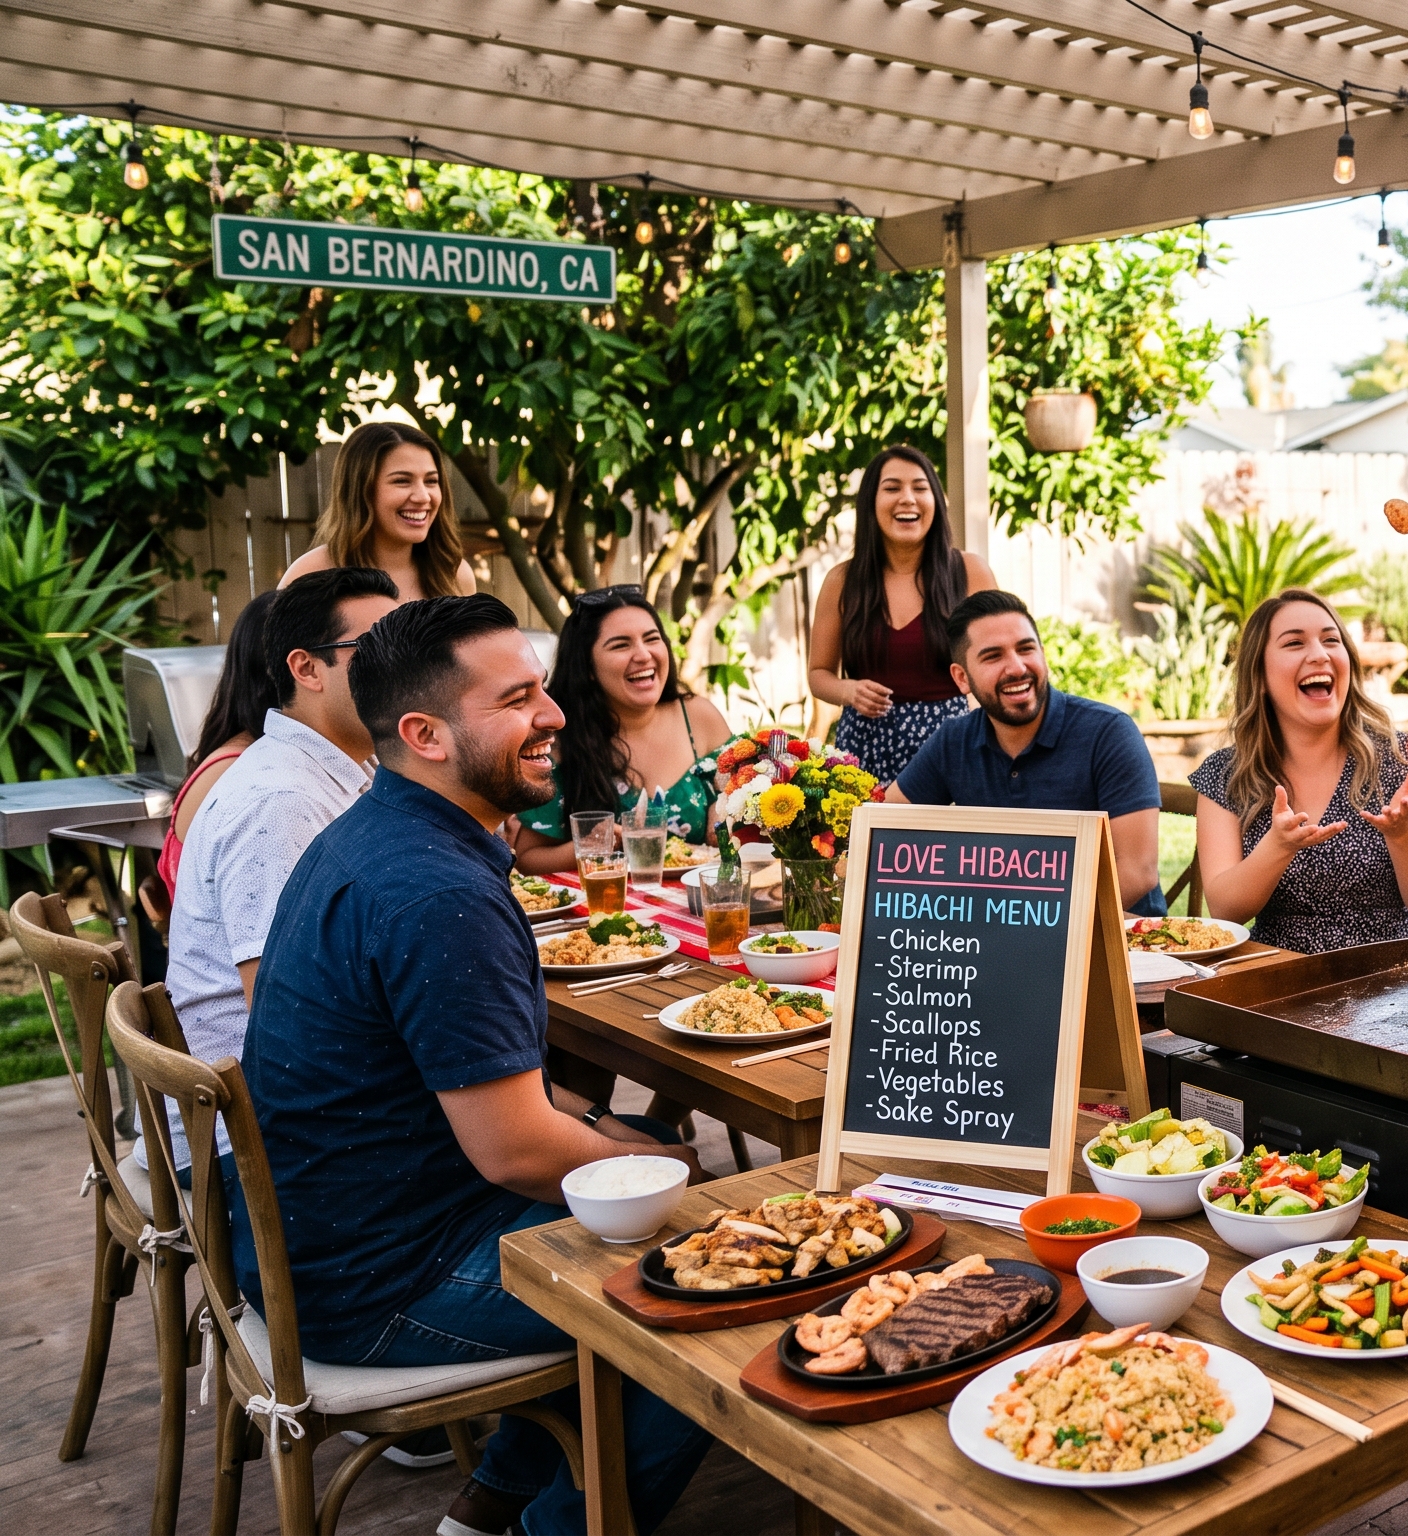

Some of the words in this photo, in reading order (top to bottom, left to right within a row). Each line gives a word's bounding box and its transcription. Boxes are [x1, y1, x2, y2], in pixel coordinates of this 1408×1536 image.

[237, 229, 310, 273] SAN
[328, 236, 548, 294] BERNARDINO,
[559, 254, 600, 292] CA
[877, 842, 947, 875] LOVE
[959, 845, 1067, 881] HIBACHI
[874, 891, 973, 923] HIBACHI
[985, 897, 1062, 927] MENU
[948, 1041, 998, 1068] Rice
[943, 1099, 1015, 1140] Spray
